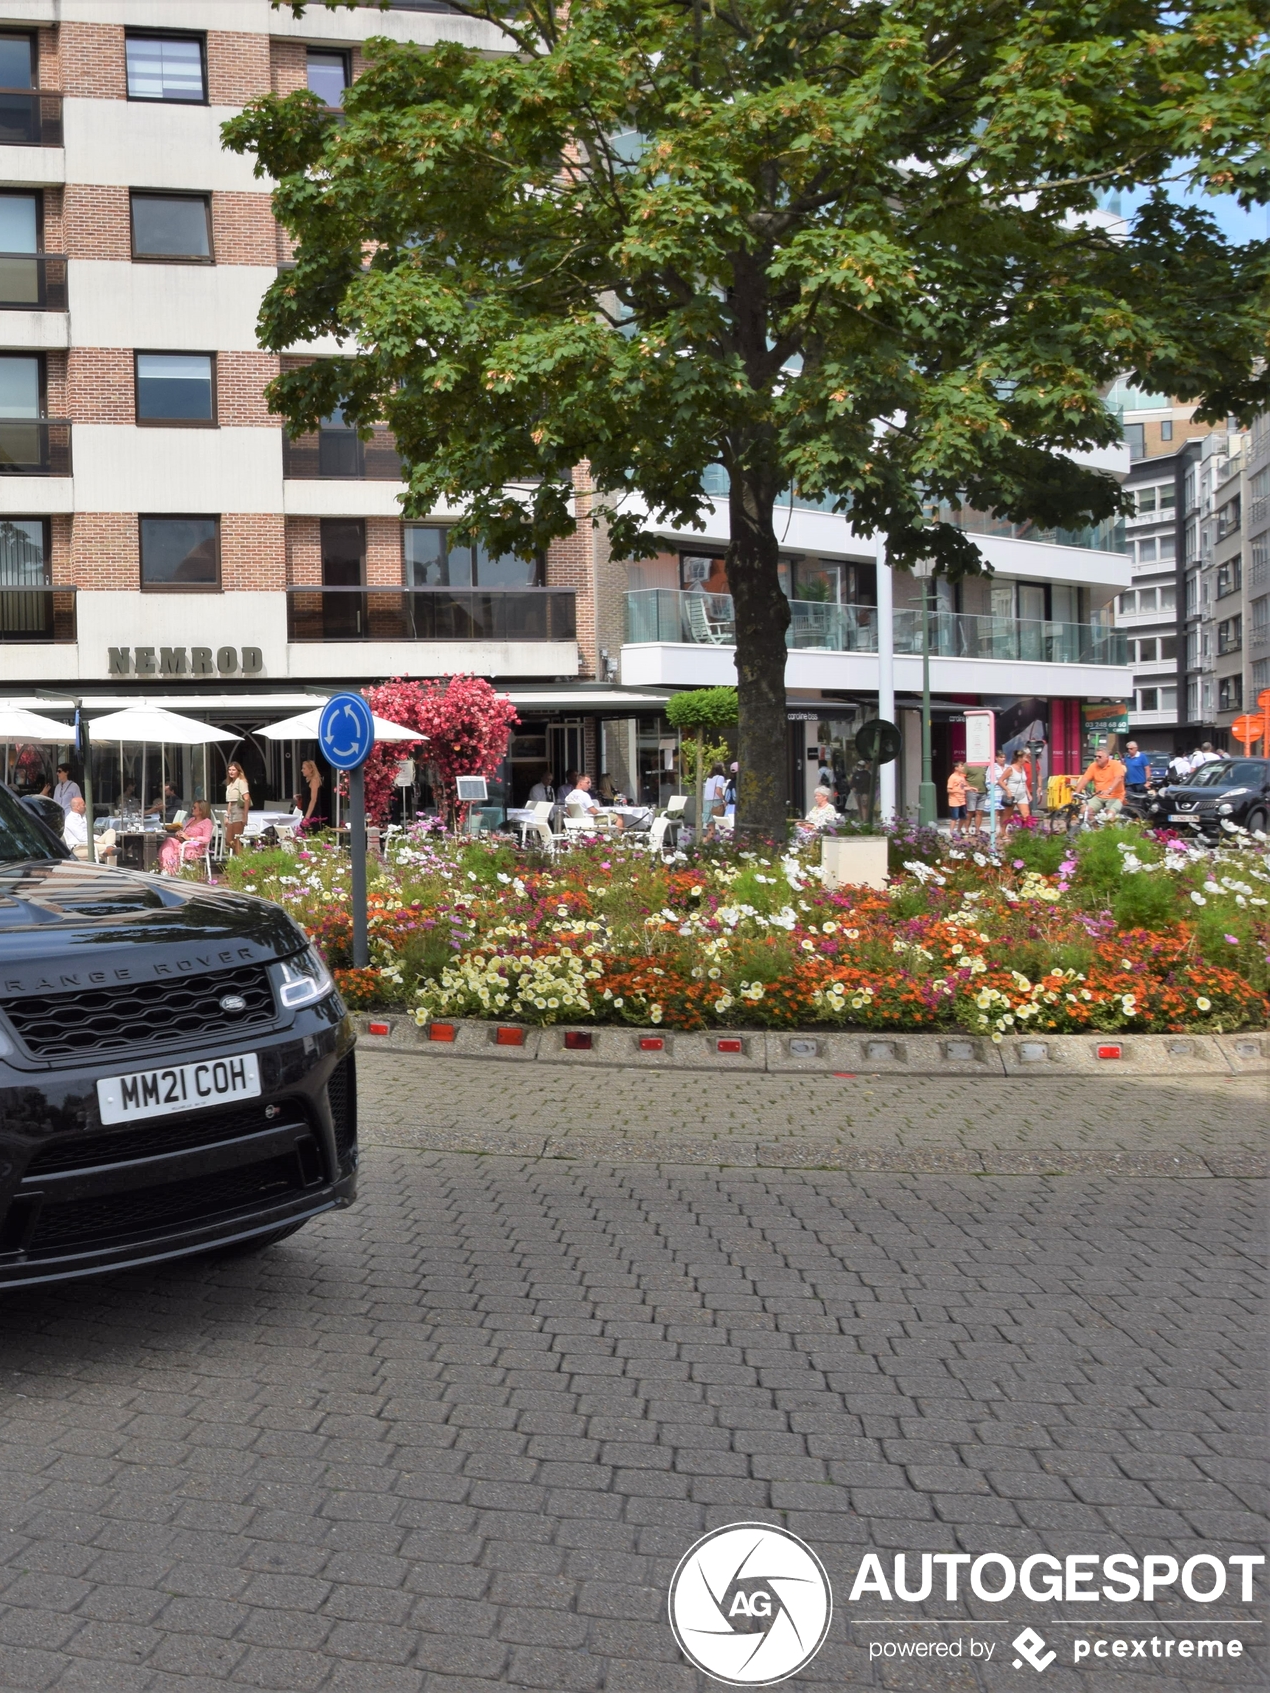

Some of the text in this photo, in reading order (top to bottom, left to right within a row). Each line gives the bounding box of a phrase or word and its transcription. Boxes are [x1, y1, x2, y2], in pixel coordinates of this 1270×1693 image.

[107, 646, 263, 674] NEMROD
[4, 947, 255, 992] RANGE ROVER
[120, 1058, 247, 1111] MM21 COH
